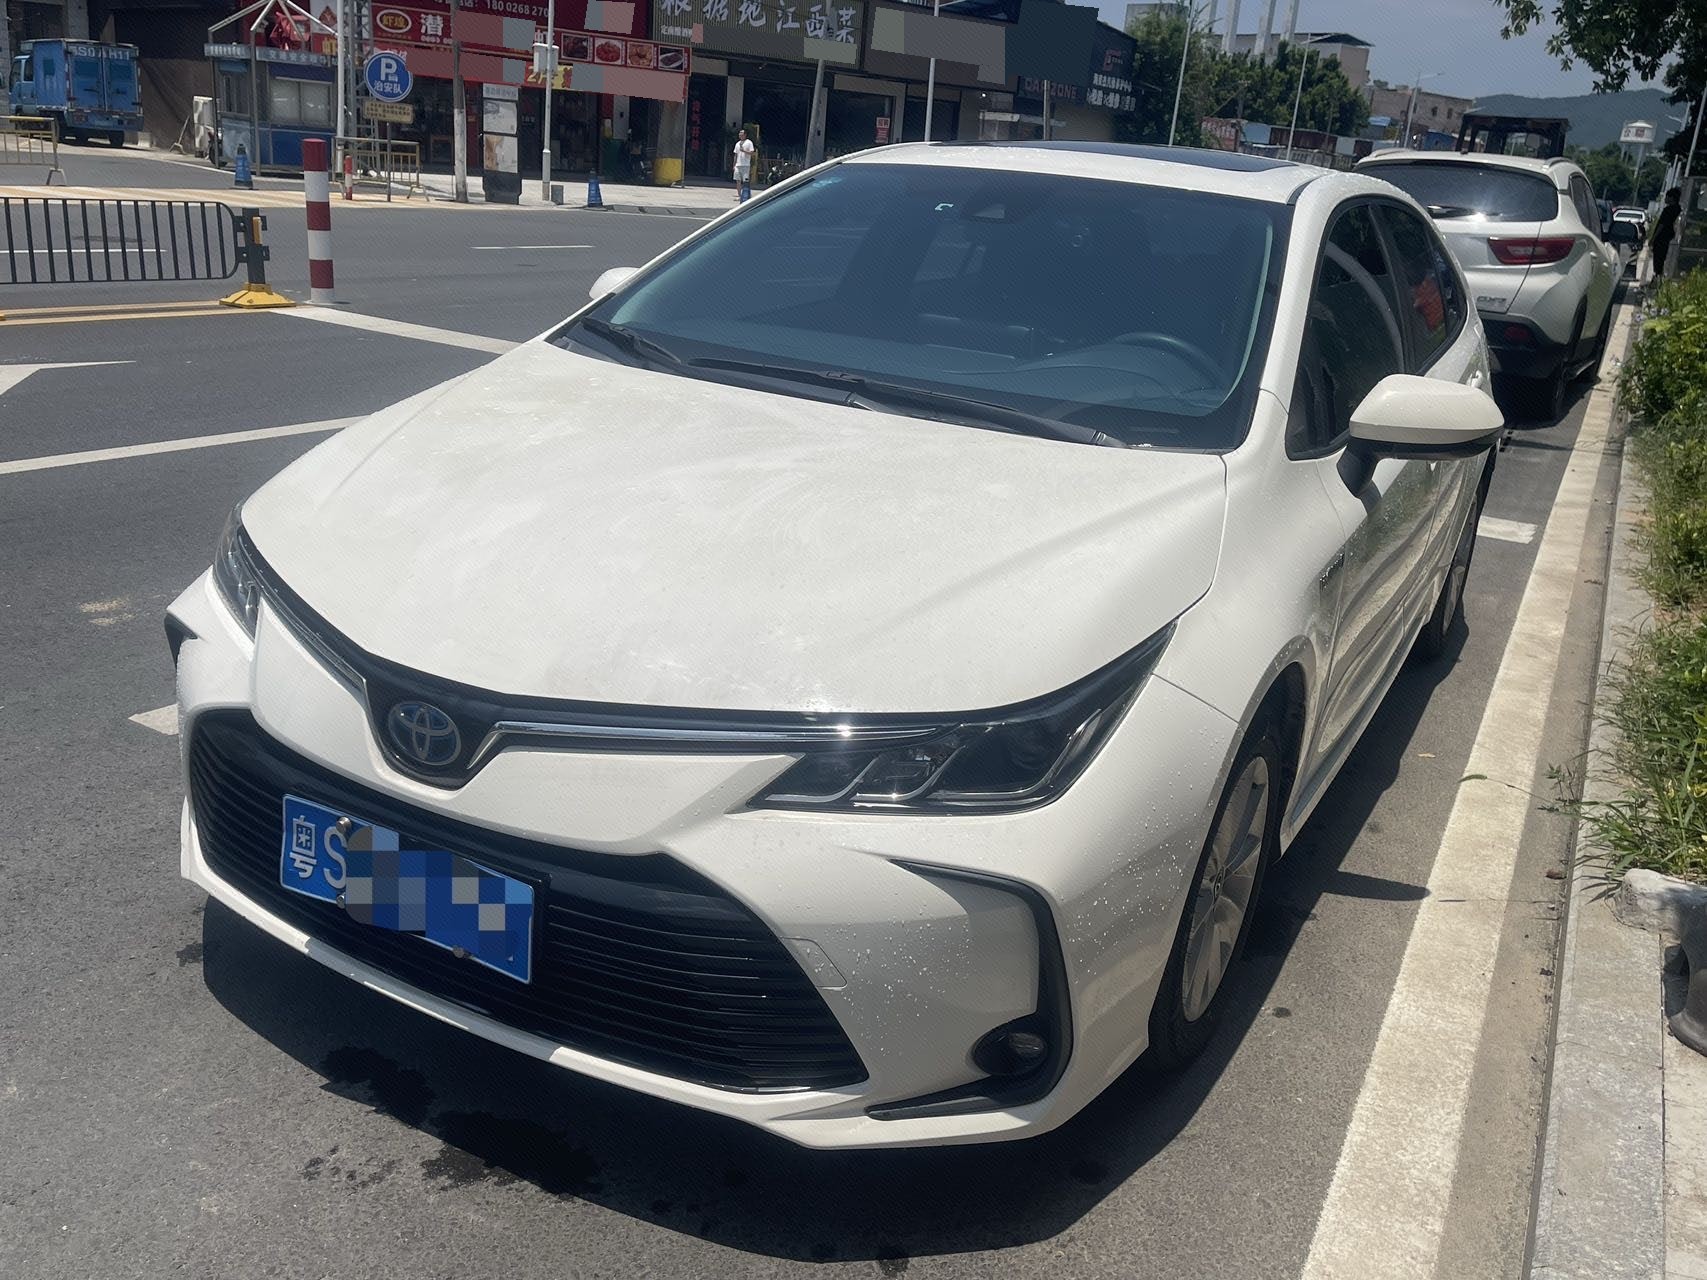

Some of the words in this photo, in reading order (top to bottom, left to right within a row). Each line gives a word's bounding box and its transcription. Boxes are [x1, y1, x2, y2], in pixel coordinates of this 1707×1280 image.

[380, 57, 398, 81] P
[373, 79, 403, 94] 治安队
